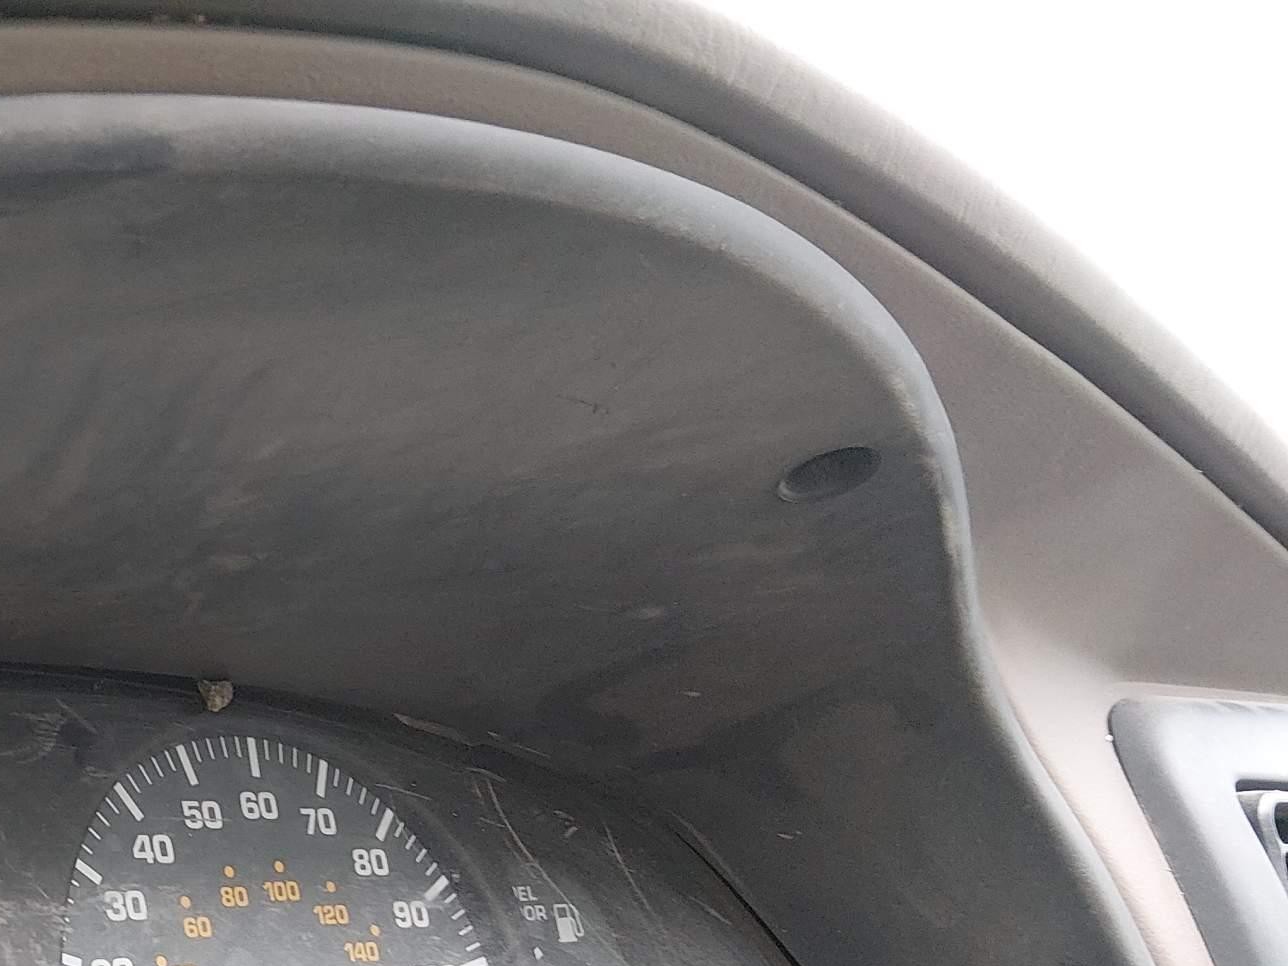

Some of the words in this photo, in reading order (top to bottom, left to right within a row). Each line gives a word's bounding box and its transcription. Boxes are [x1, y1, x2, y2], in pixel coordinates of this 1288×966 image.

[181, 800, 223, 829] 50
[240, 791, 279, 820] 60
[300, 808, 337, 835] 70
[132, 834, 175, 864] 40
[352, 849, 390, 876] 80
[220, 886, 249, 907] 80
[264, 881, 300, 902] 100
[104, 890, 148, 921] 30
[314, 904, 349, 925] 120
[392, 901, 430, 928] 90
[520, 905, 547, 921] OR
[183, 916, 212, 938] 60
[344, 942, 380, 962] 140
